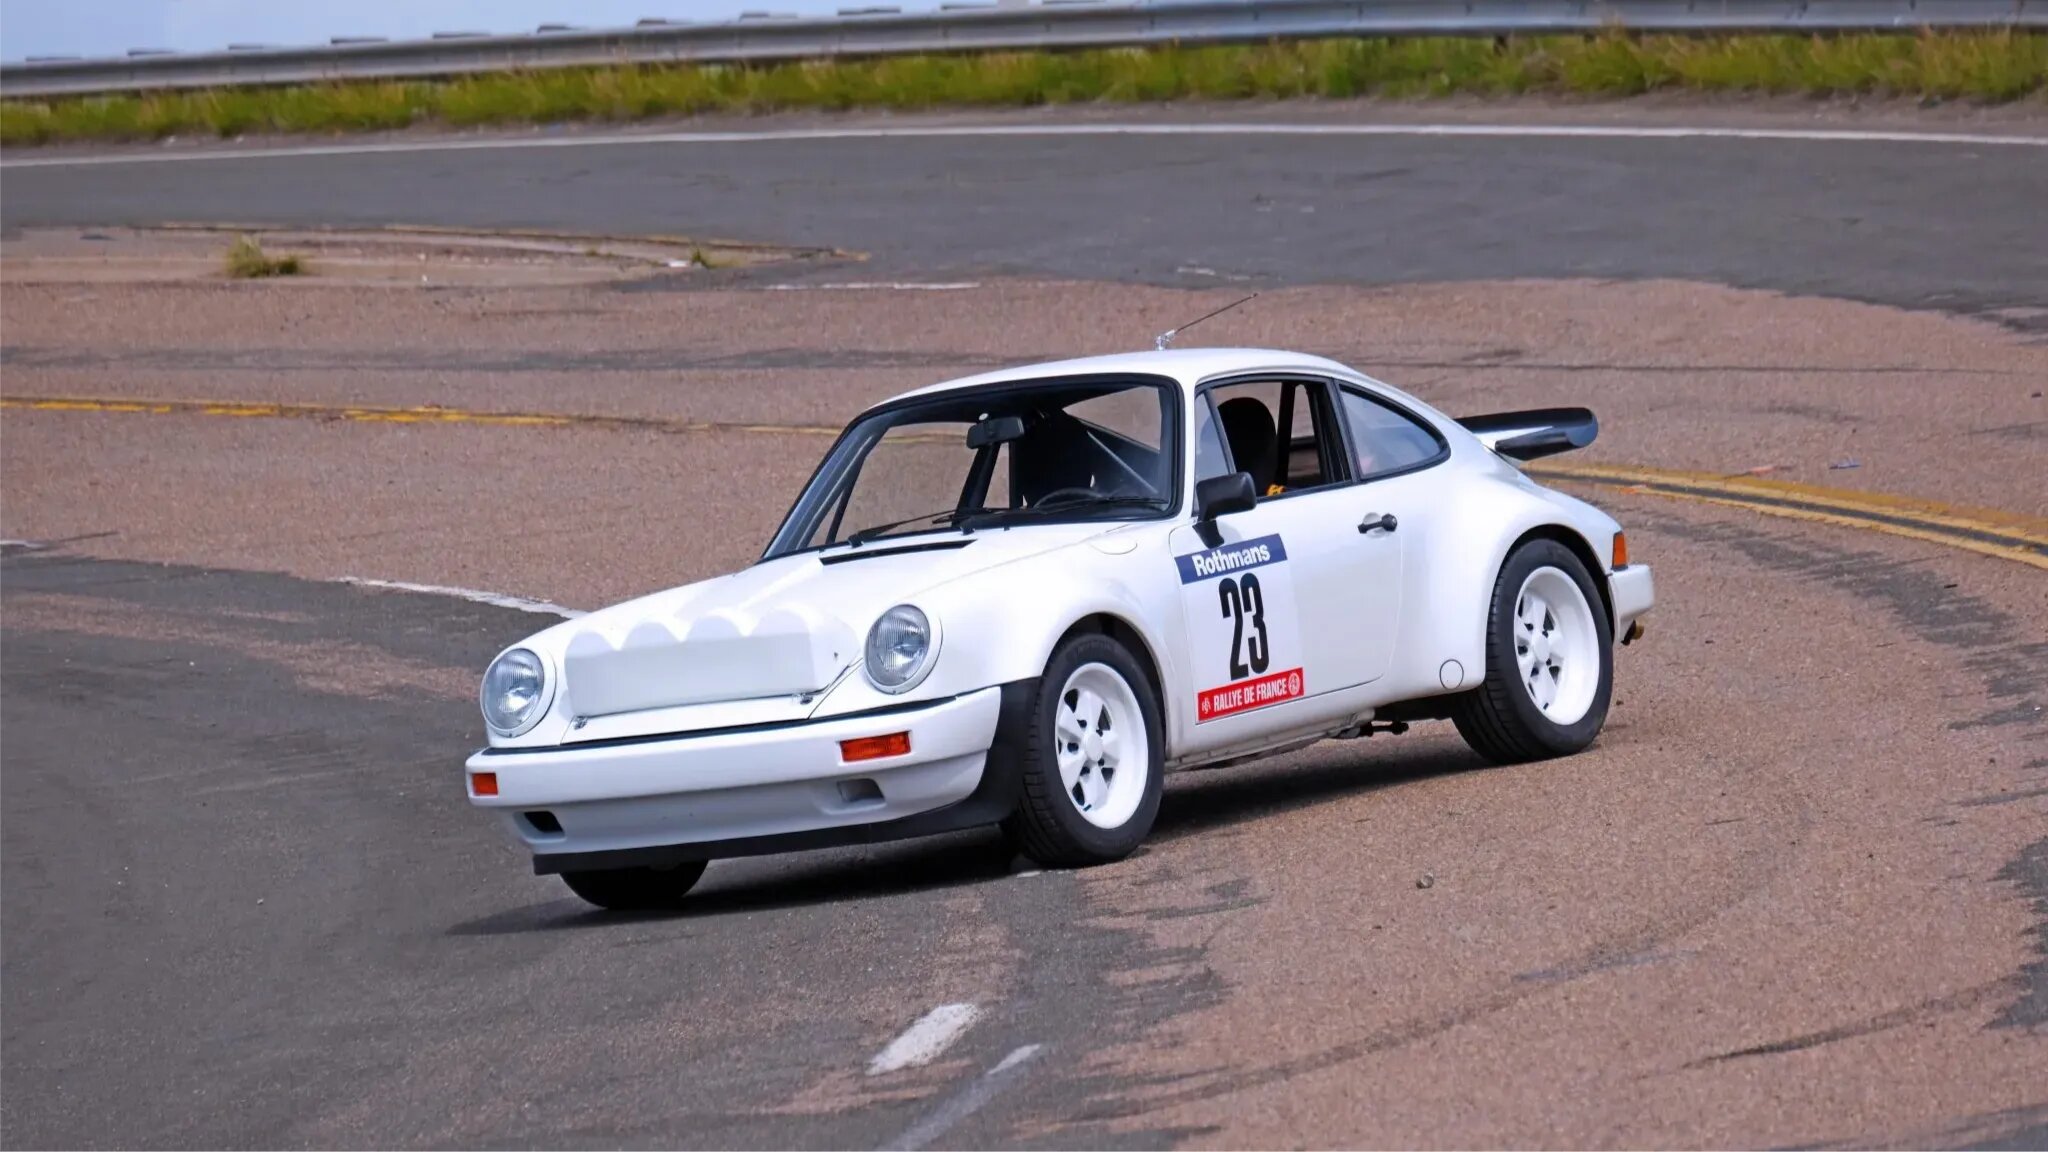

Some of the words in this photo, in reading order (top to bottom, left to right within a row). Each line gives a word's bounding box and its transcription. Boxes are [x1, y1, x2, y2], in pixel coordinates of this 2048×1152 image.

[1192, 544, 1270, 577] Rothmans
[1219, 572, 1270, 681] 23
[1213, 688, 1243, 712] RALLYE
[1243, 685, 1255, 705] DE
[1256, 678, 1287, 702] FRANCE
